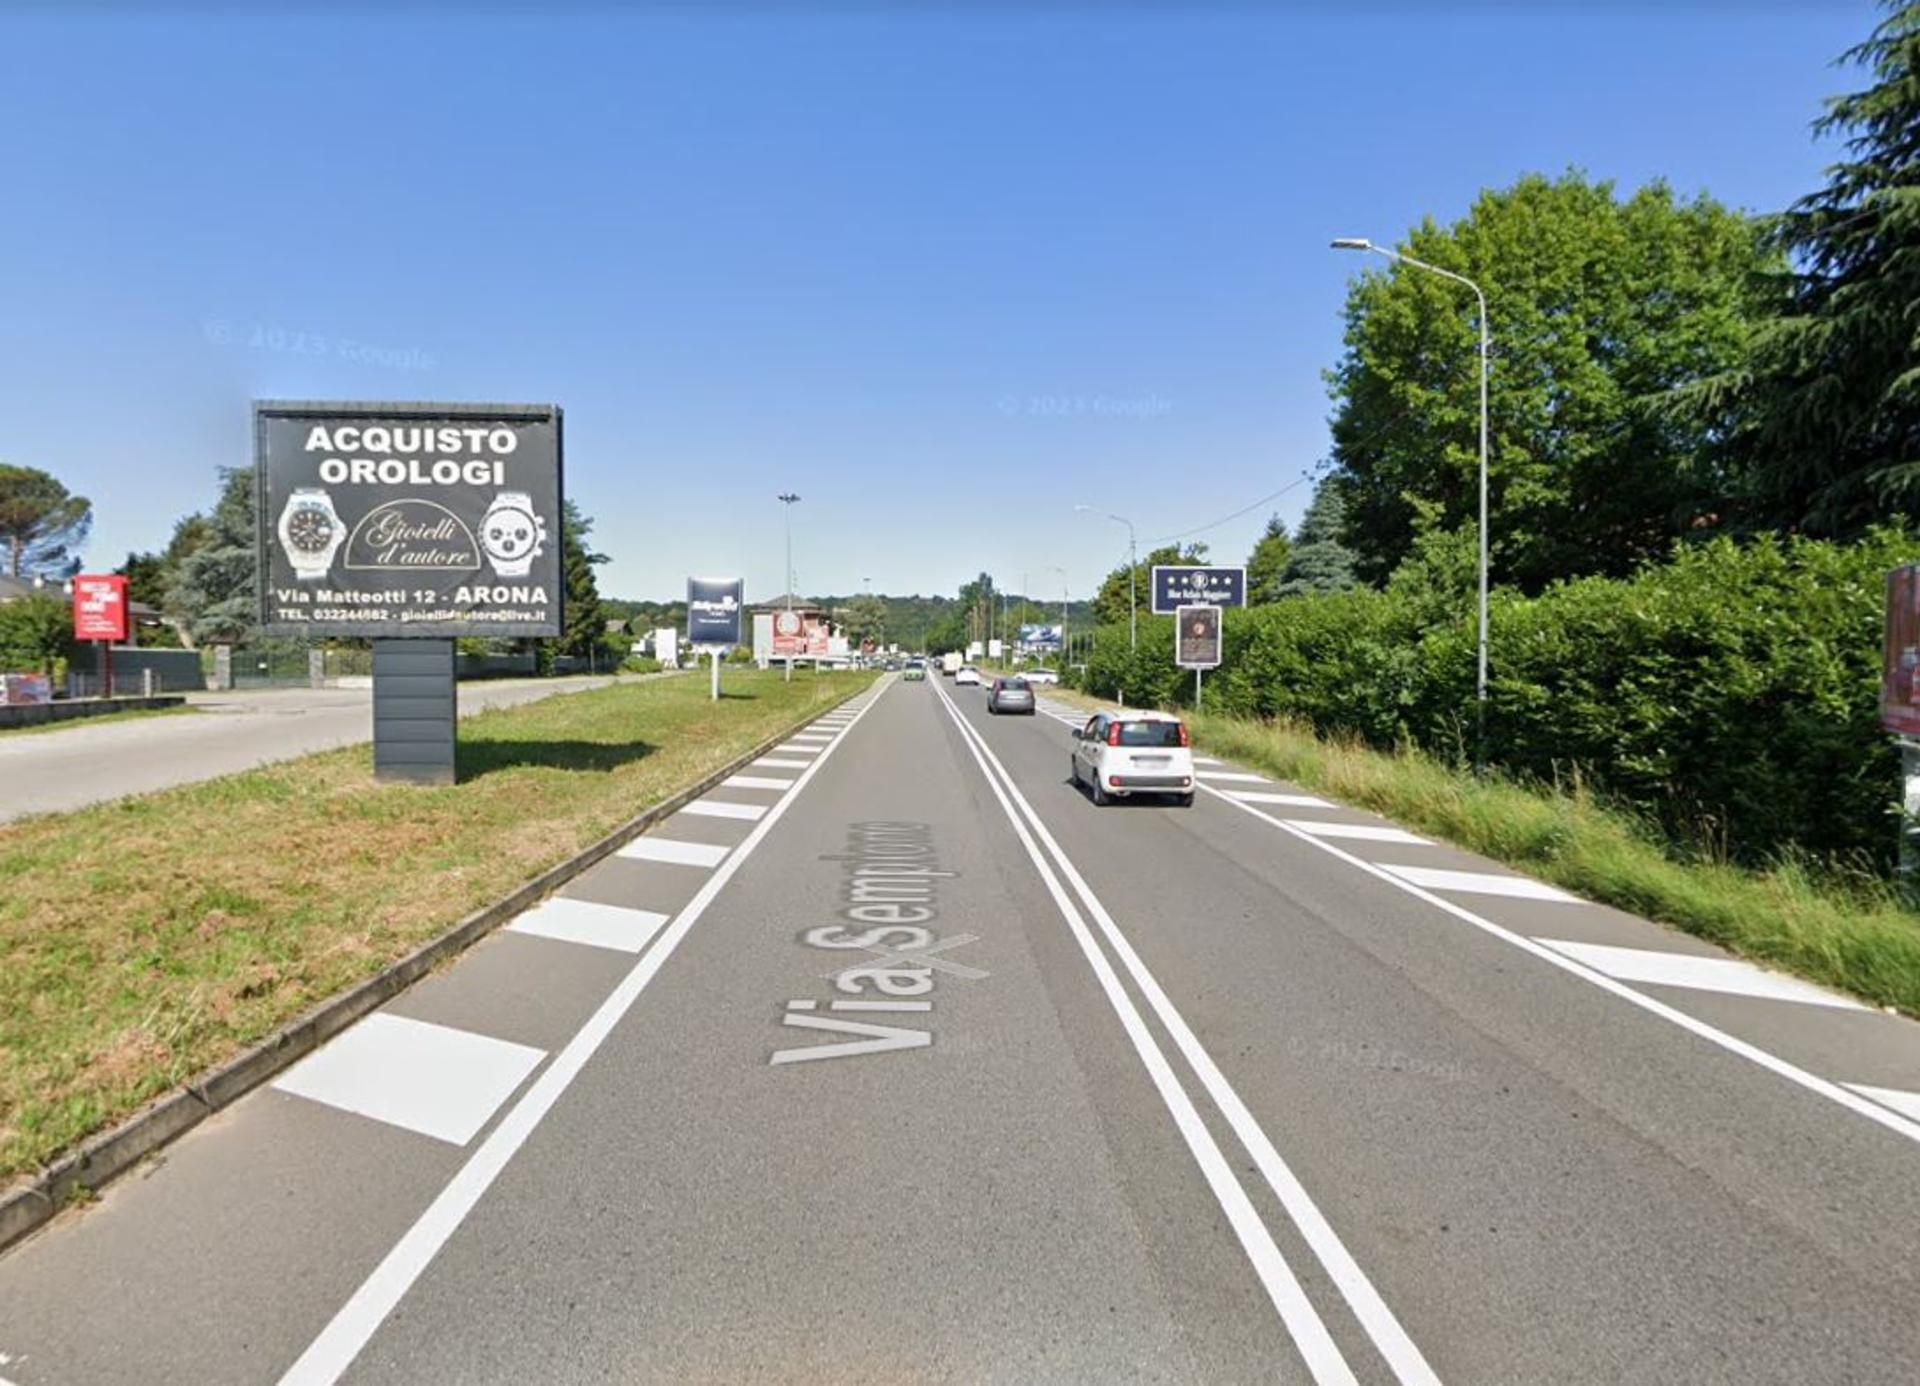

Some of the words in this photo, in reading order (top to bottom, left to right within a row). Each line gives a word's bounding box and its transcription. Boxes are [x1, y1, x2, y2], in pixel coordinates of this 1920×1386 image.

[304, 426, 518, 455] ACQUISTO
[318, 458, 505, 486] OROLOGI
[365, 508, 456, 547] Gioielli
[376, 542, 471, 566] d'autore
[277, 588, 310, 603] Via
[316, 589, 407, 603] Matteotti
[413, 589, 437, 604] 12
[454, 585, 549, 604] ARONA
